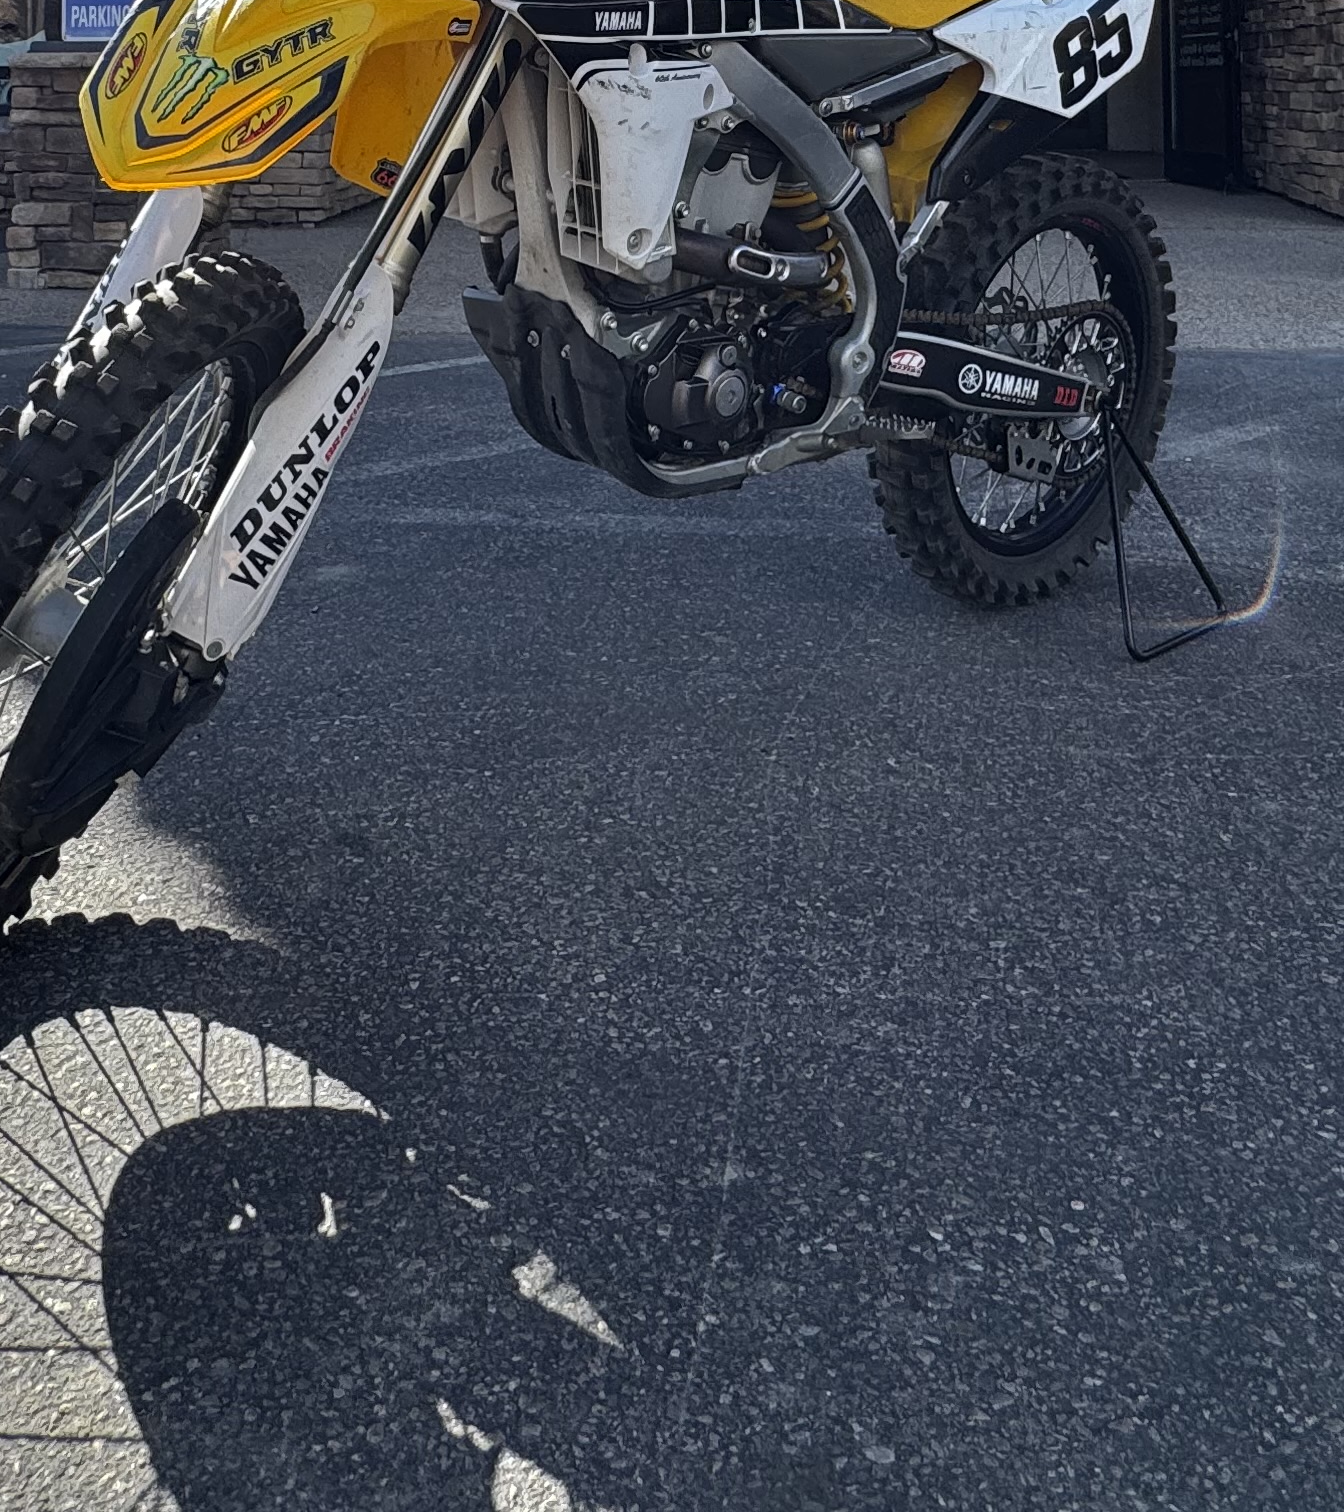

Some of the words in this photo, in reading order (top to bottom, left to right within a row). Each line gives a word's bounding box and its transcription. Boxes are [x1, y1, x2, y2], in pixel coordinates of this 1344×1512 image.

[231, 17, 337, 85] GYTR
[594, 10, 643, 32] YAMAHA
[228, 97, 288, 152] FMF
[985, 370, 1040, 401] YAMAHA
[229, 340, 381, 553] DUNLOP
[228, 466, 329, 591] YAMAHA
